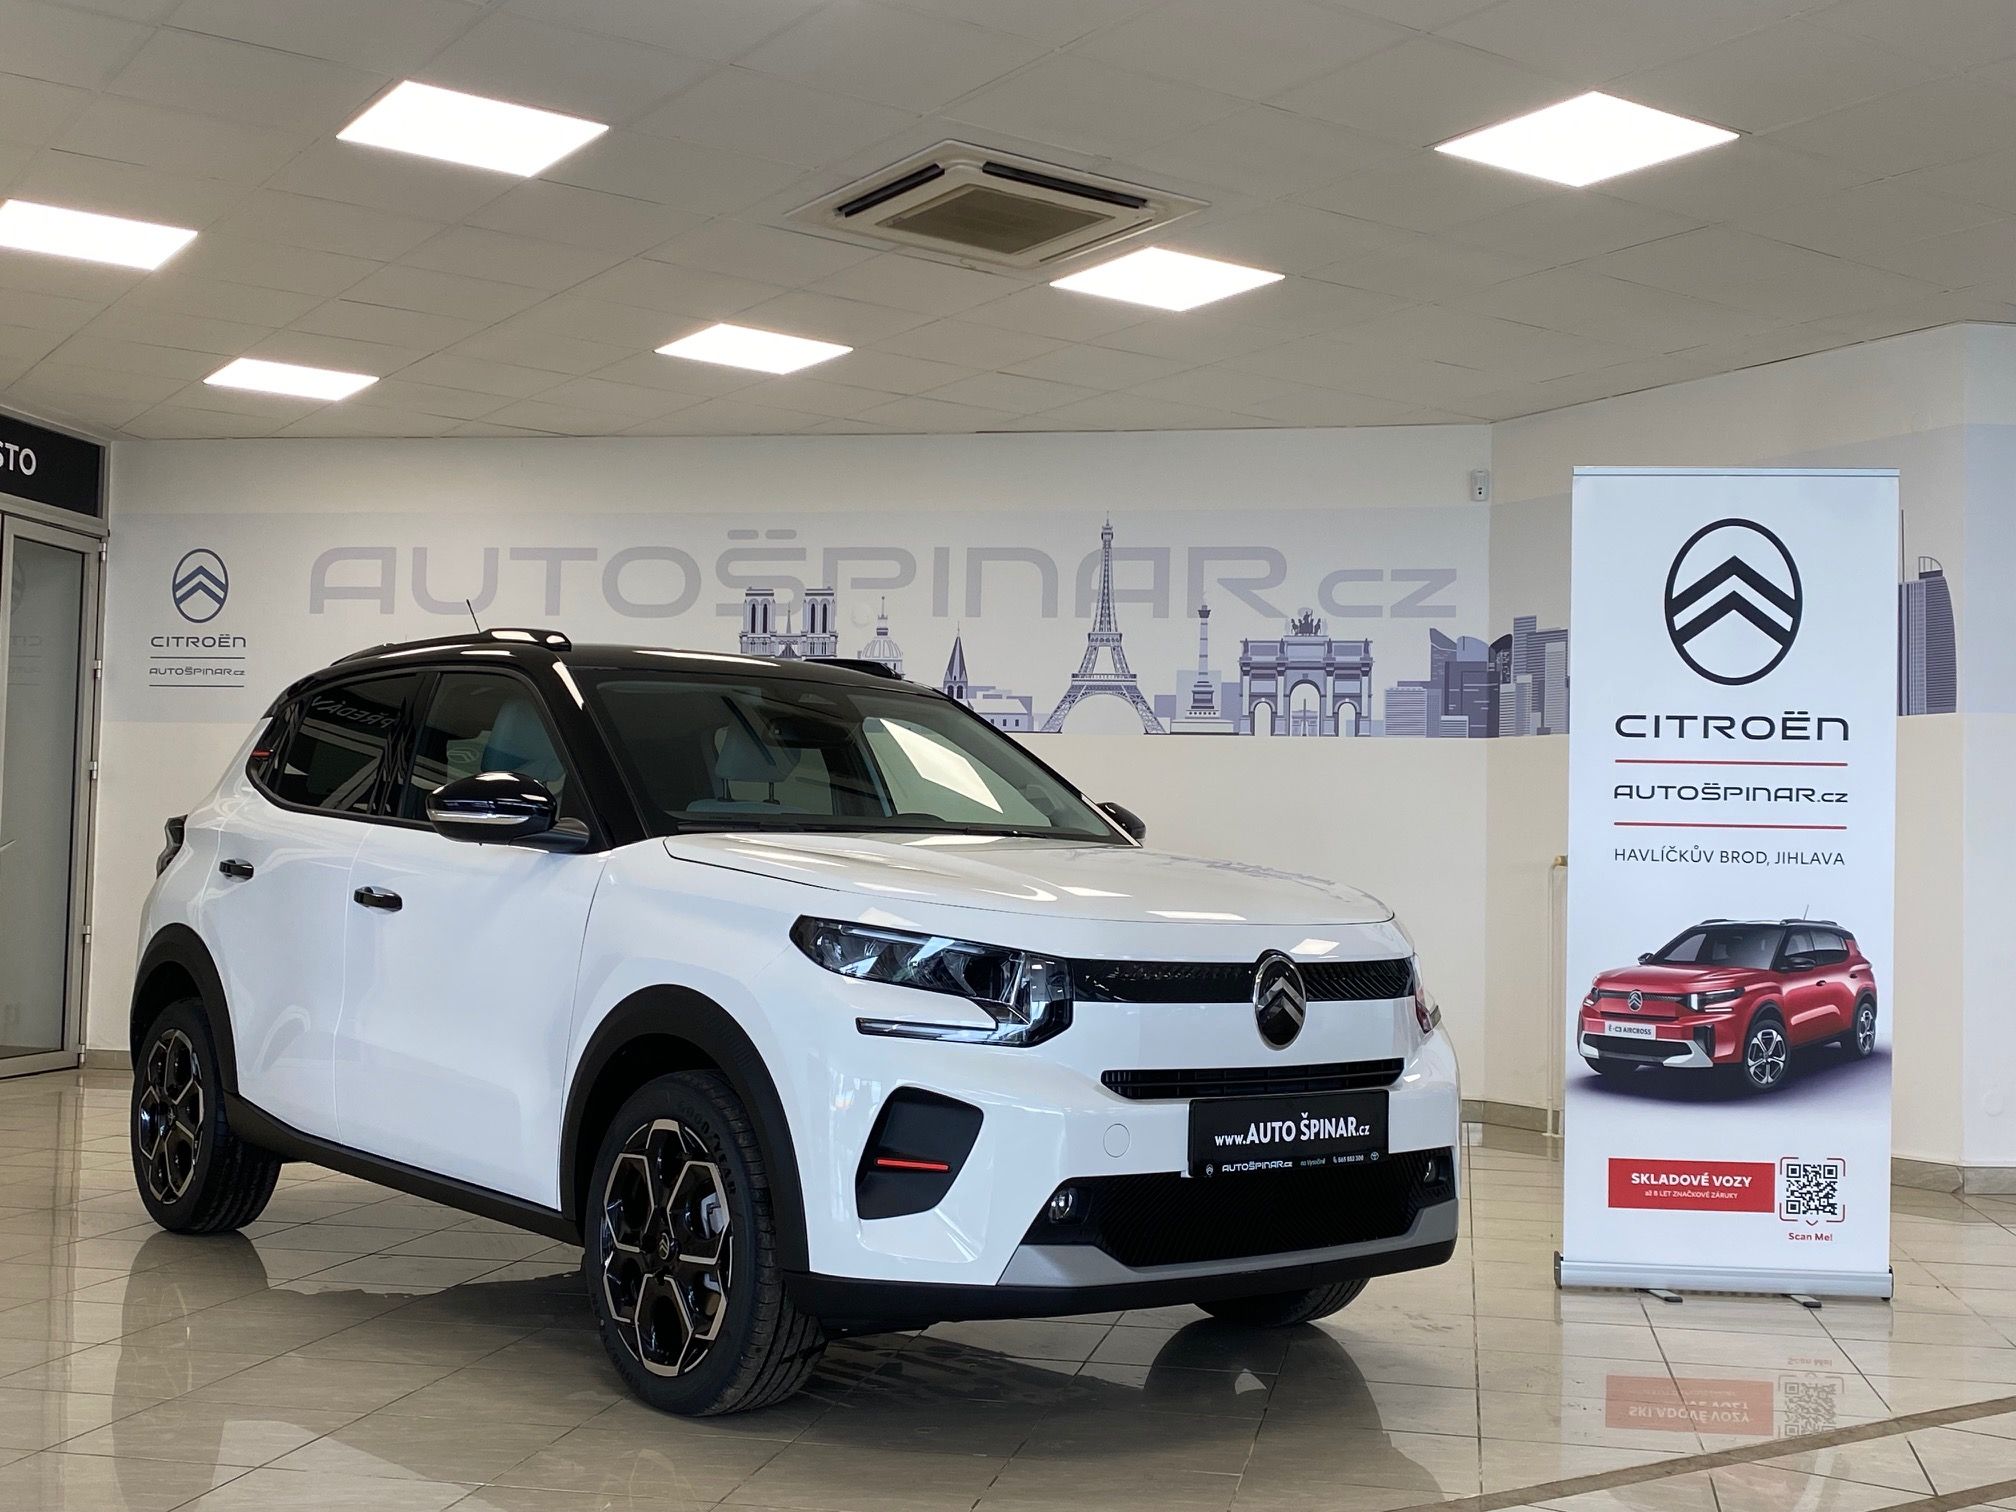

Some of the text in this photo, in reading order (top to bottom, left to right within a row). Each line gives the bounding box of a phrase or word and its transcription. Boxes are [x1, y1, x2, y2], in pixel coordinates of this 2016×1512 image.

[0, 441, 37, 475] TO
[150, 633, 246, 648] CITROËN
[1615, 711, 1849, 741] CITROËN
[1613, 782, 1848, 803] AUTOŠPINAR.cz
[1614, 845, 1846, 866] HAVLÍČKŮV BROD, JIHLAVA
[1623, 1027, 1651, 1035] AIRCROSS
[1300, 1112, 1370, 1141] ŠPINAR.cz
[1631, 1172, 1752, 1188] SKLADOVÉ VOZY
[1673, 1190, 1709, 1198] ZNAČKOVÉ
[1711, 1191, 1738, 1199] ZÁRUKY
[1789, 1233, 1833, 1242] Scan Me!
